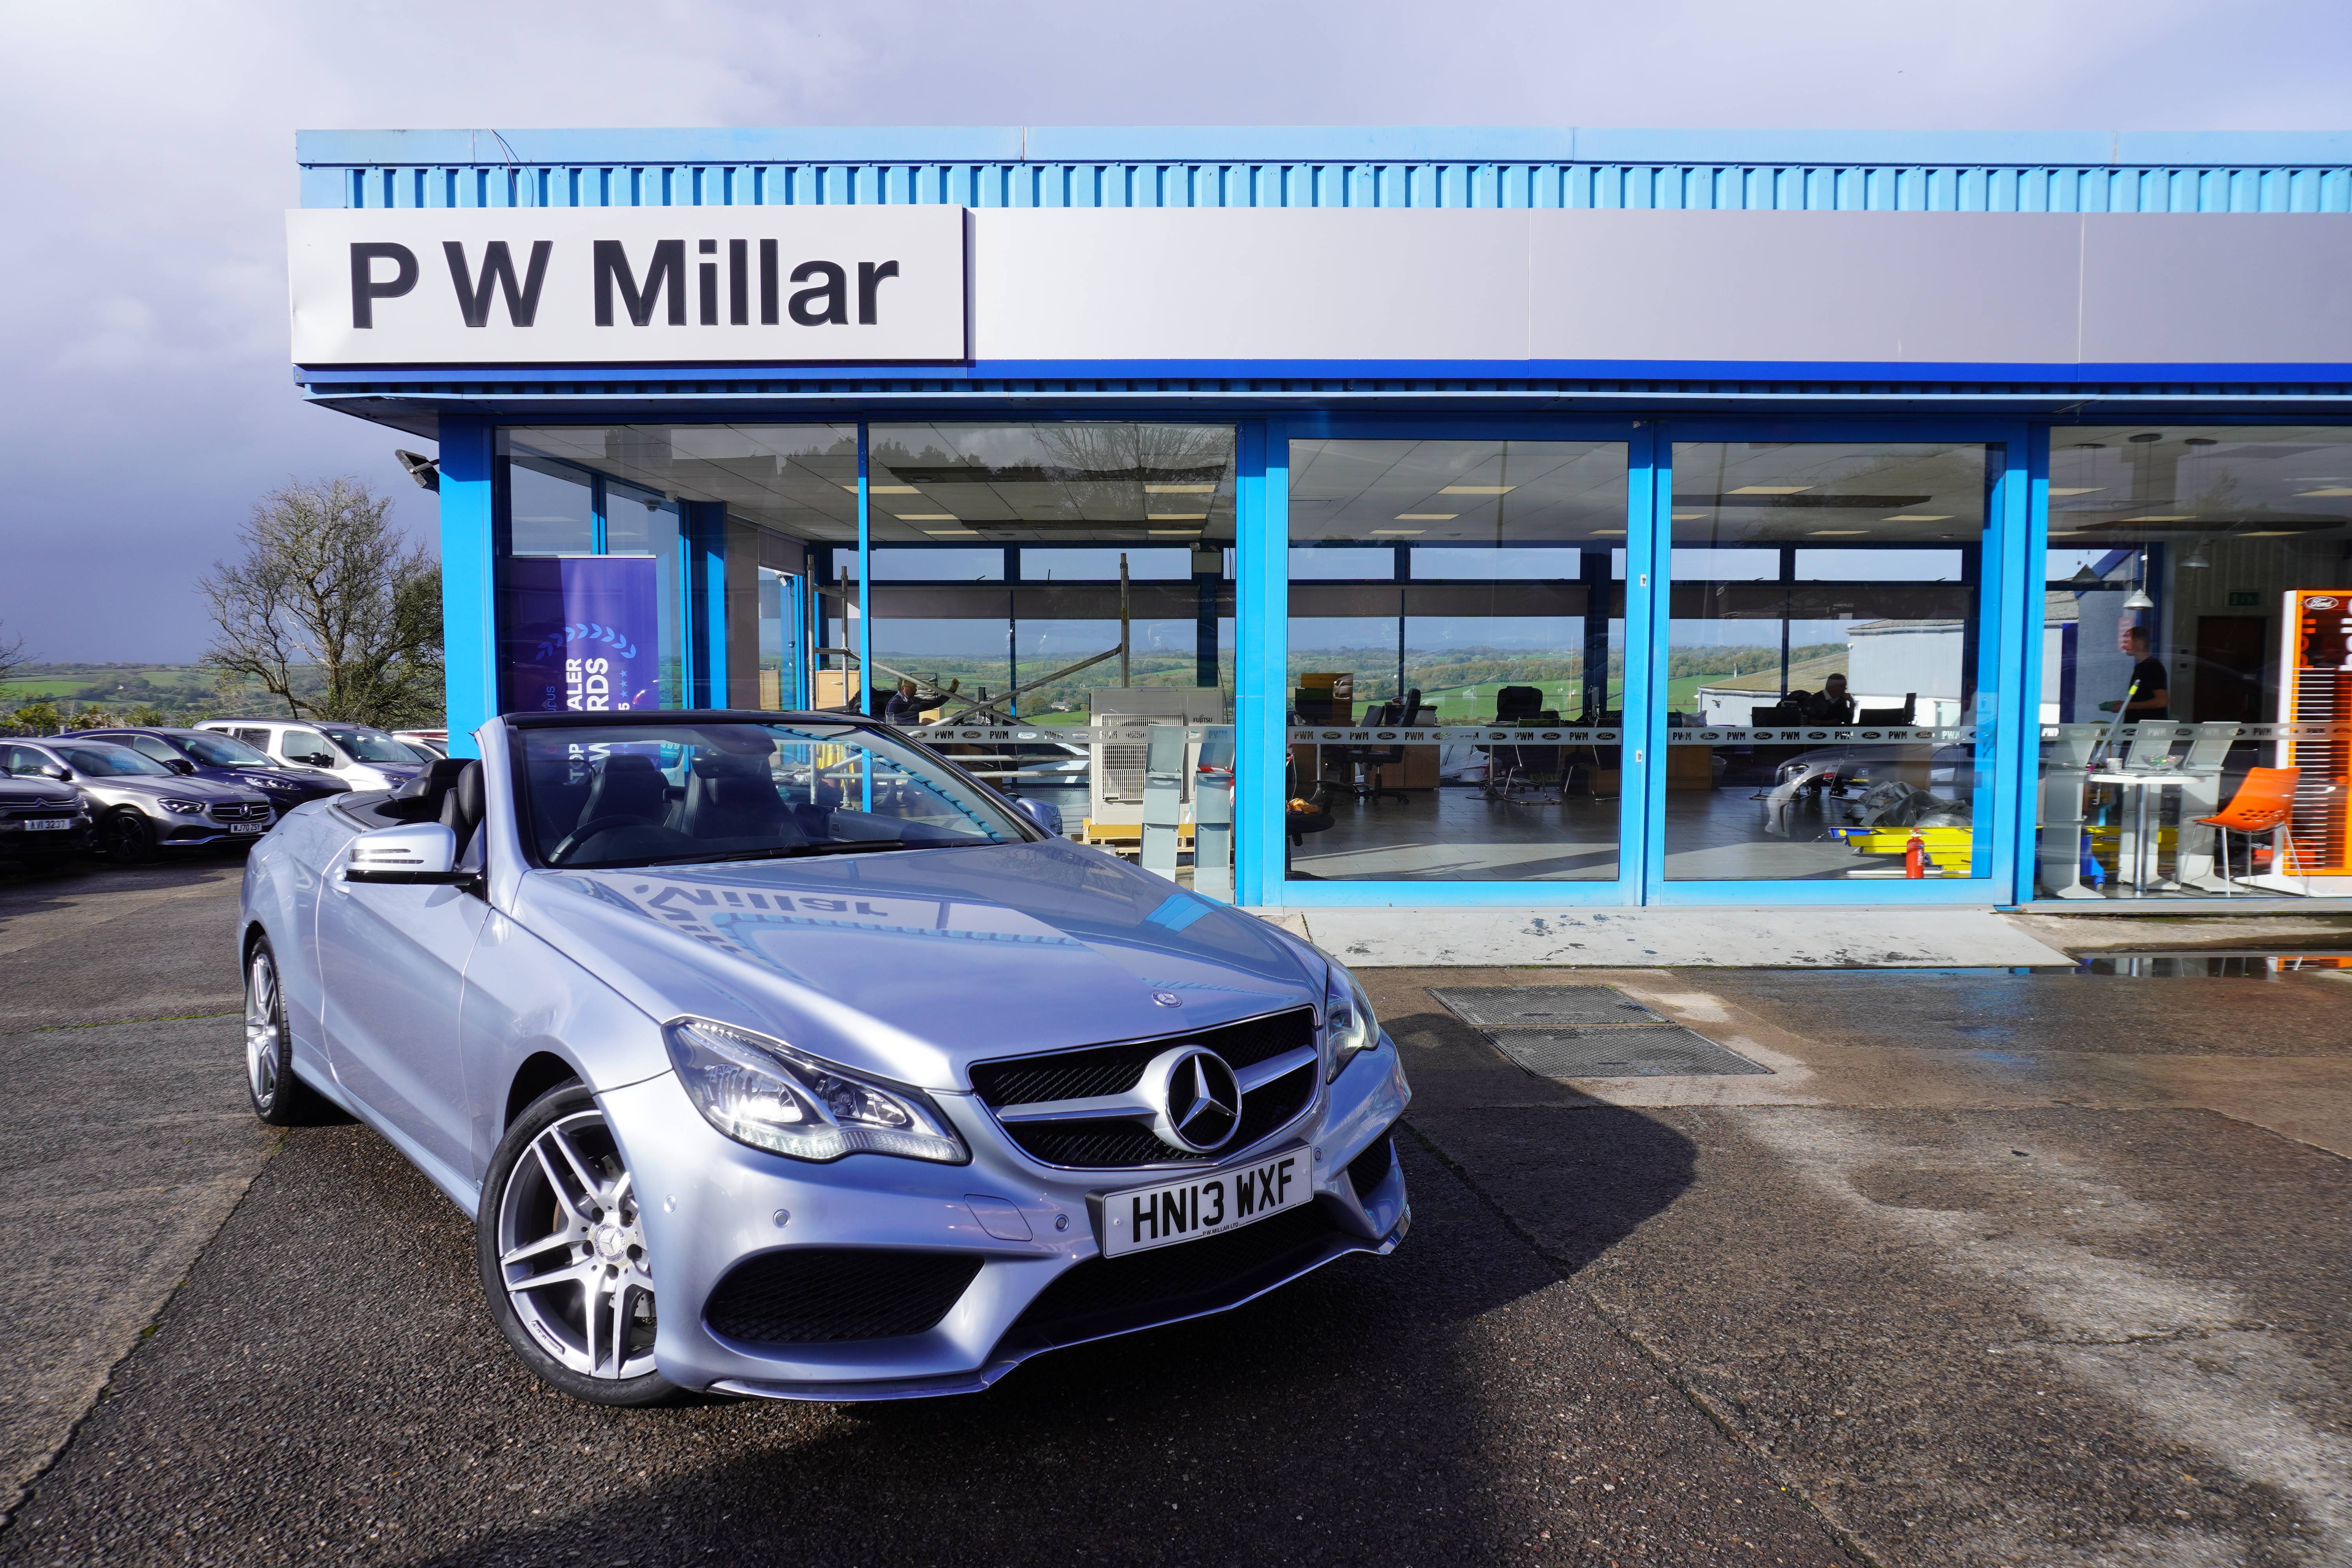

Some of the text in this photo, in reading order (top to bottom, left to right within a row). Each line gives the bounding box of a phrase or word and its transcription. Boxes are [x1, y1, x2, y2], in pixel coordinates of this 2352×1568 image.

[350, 238, 900, 330] P W Millar
[565, 658, 583, 711] ALER
[1193, 714, 1213, 724] FUJITSU
[935, 730, 954, 739] PWM
[990, 731, 1009, 739] PWM
[1044, 731, 1063, 739] PWM
[1209, 730, 1228, 739] PWM
[1294, 731, 1314, 740] PWM
[1350, 731, 1369, 740] PWM
[1405, 732, 1424, 740] PWM
[1515, 732, 1534, 740] PWM
[1569, 732, 1588, 740] PWM
[1727, 732, 1746, 740] PWM
[1781, 731, 1800, 740] PWM
[1888, 731, 1907, 739] PWM
[1942, 730, 1960, 739] PWM
[1133, 1158, 1295, 1243] HN13 WXF
[1202, 1225, 1230, 1237] P.W.MILLAR
